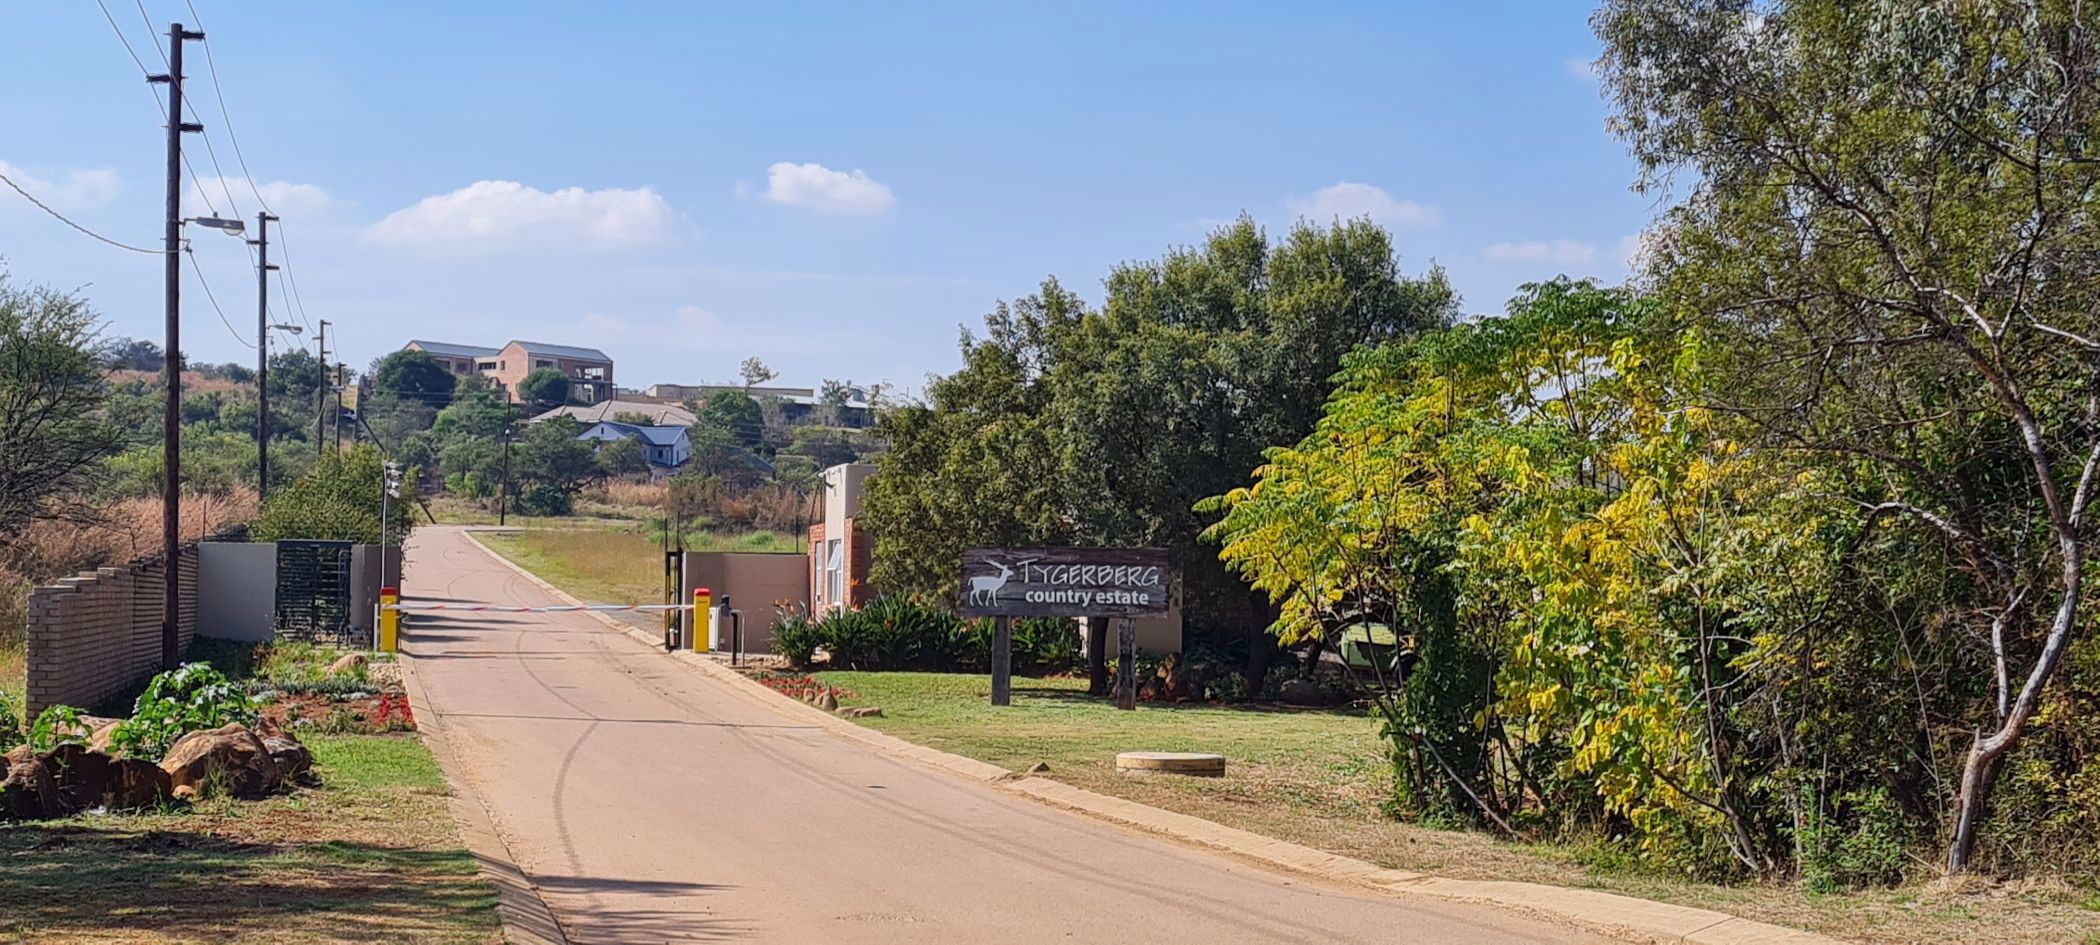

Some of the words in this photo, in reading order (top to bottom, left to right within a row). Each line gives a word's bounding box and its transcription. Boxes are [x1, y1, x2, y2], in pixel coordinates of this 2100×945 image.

[1017, 558, 1159, 586] TYGERBERG
[1025, 589, 1092, 606] country
[1095, 590, 1149, 605] estate
